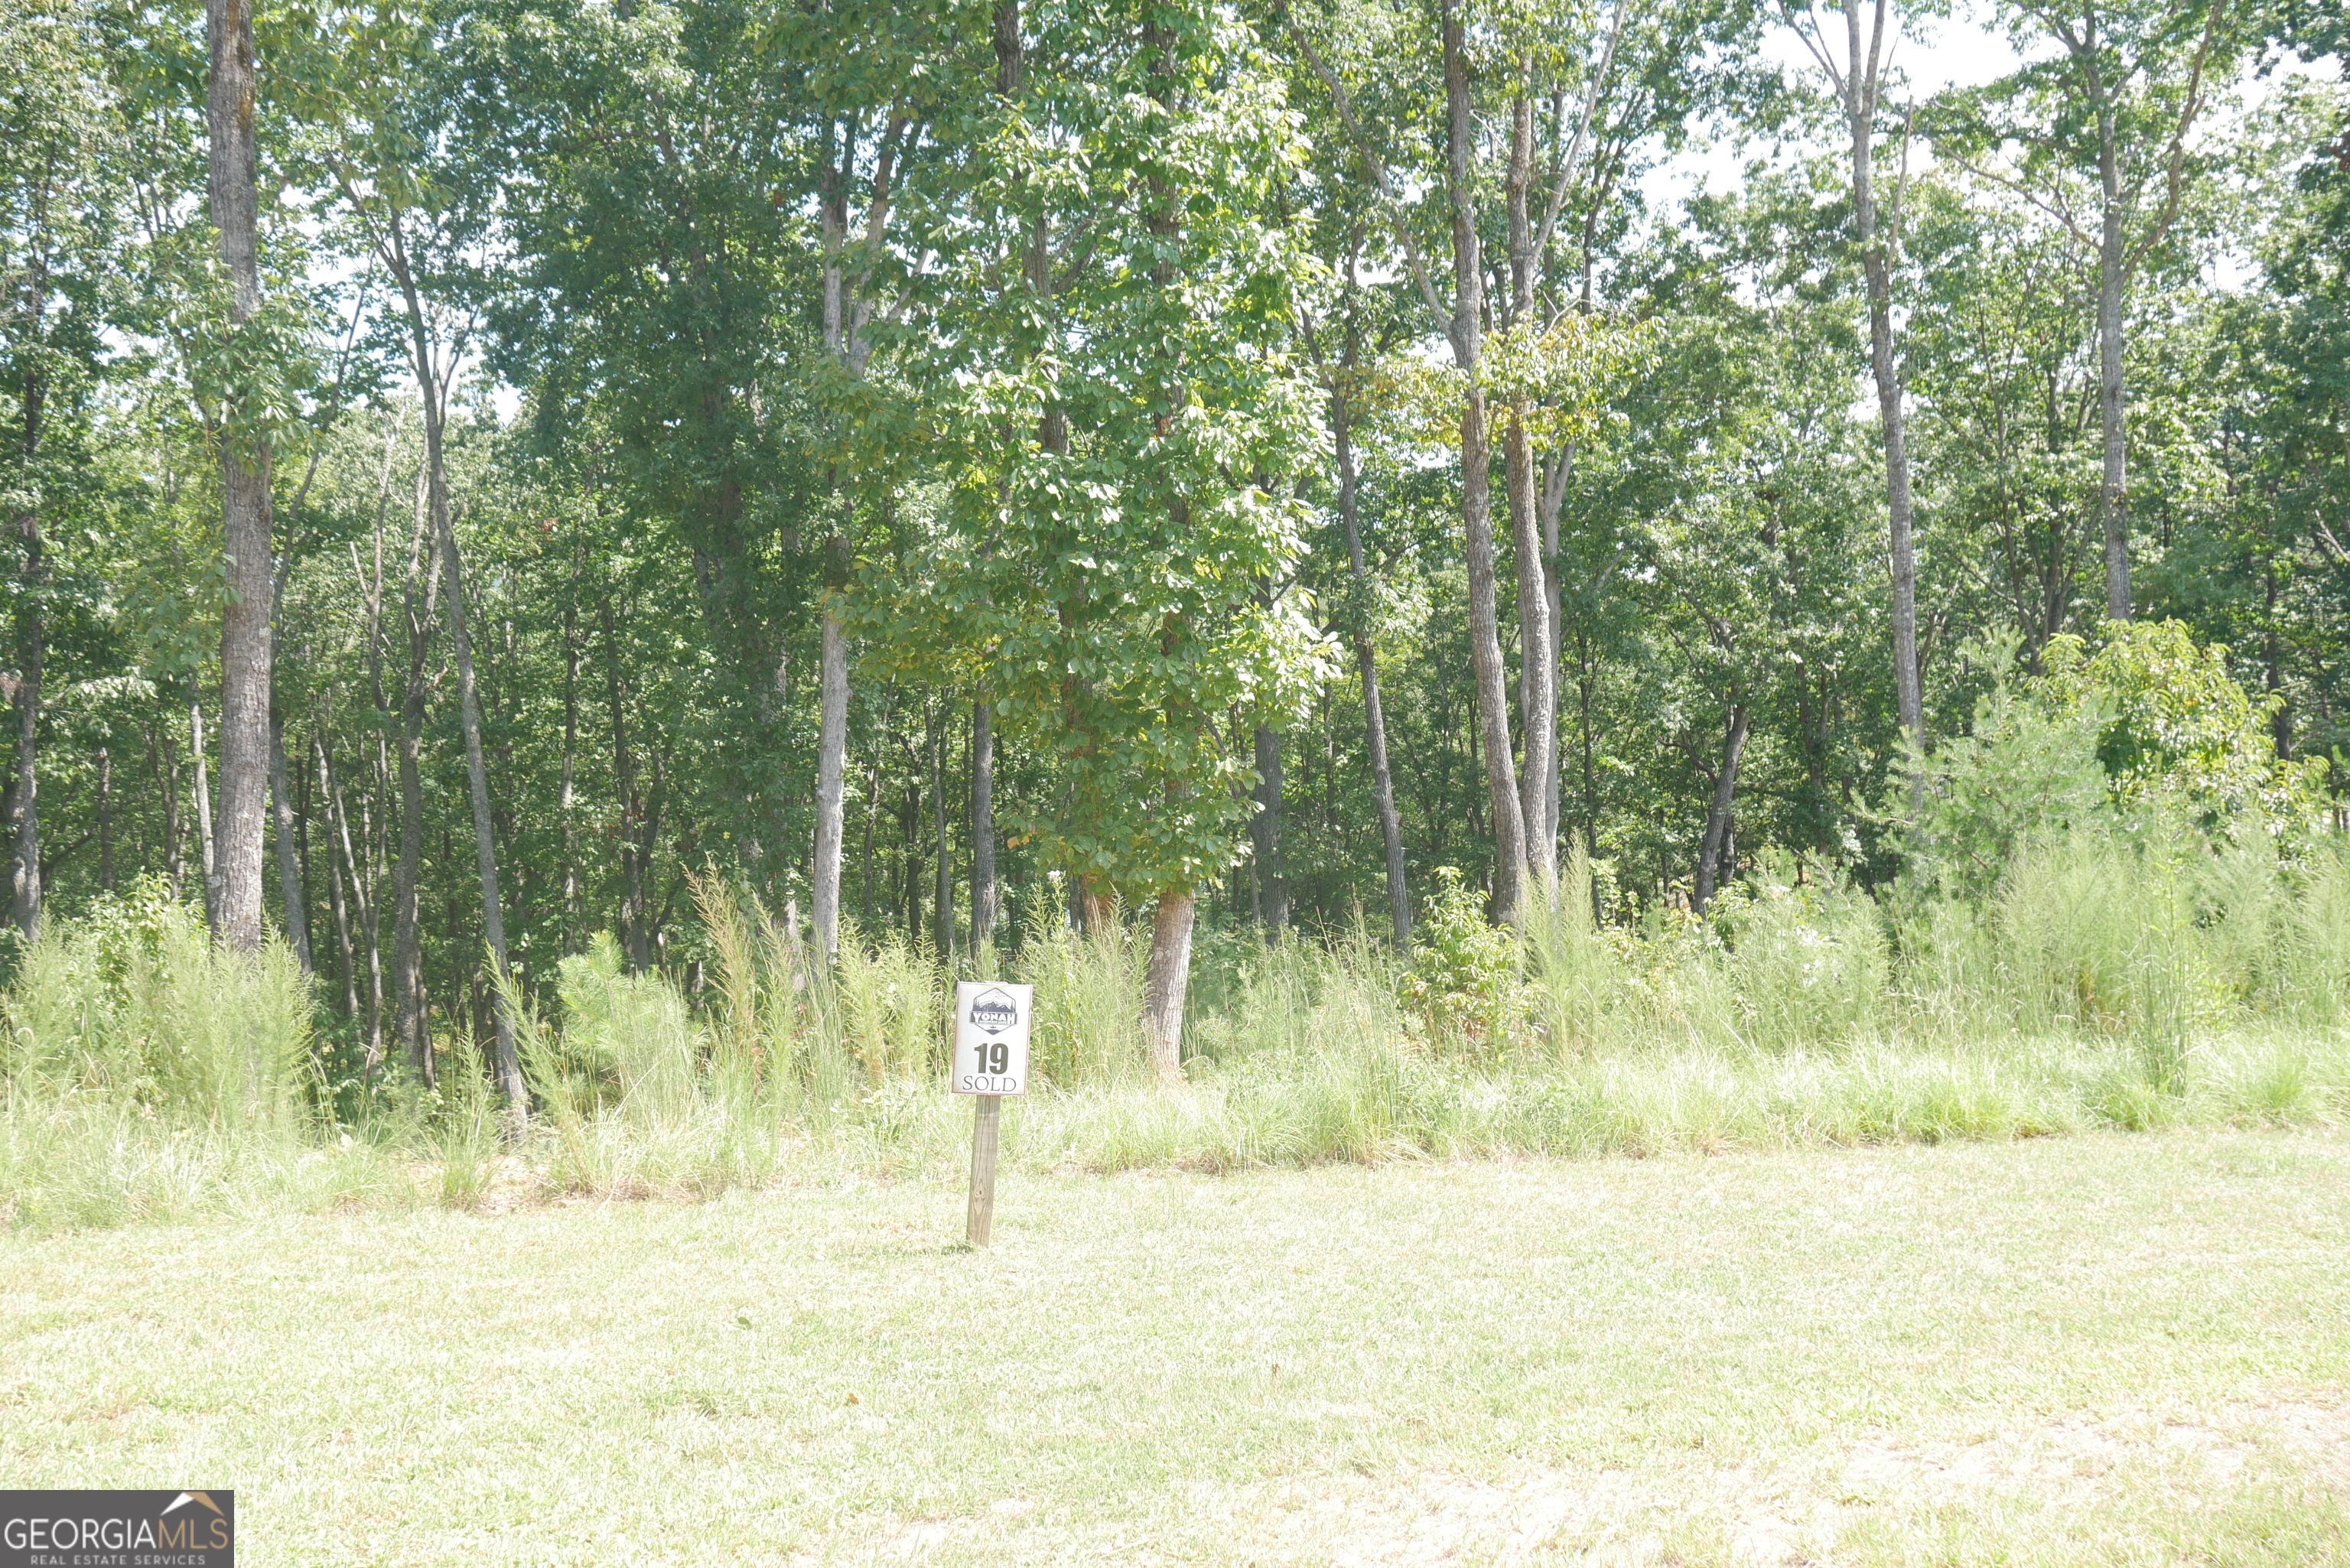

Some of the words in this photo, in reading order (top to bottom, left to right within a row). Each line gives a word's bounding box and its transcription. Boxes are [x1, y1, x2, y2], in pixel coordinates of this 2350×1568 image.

[973, 1012, 1015, 1024] YONAH
[974, 1043, 1009, 1075] 19
[962, 1075, 1017, 1092] SOLD
